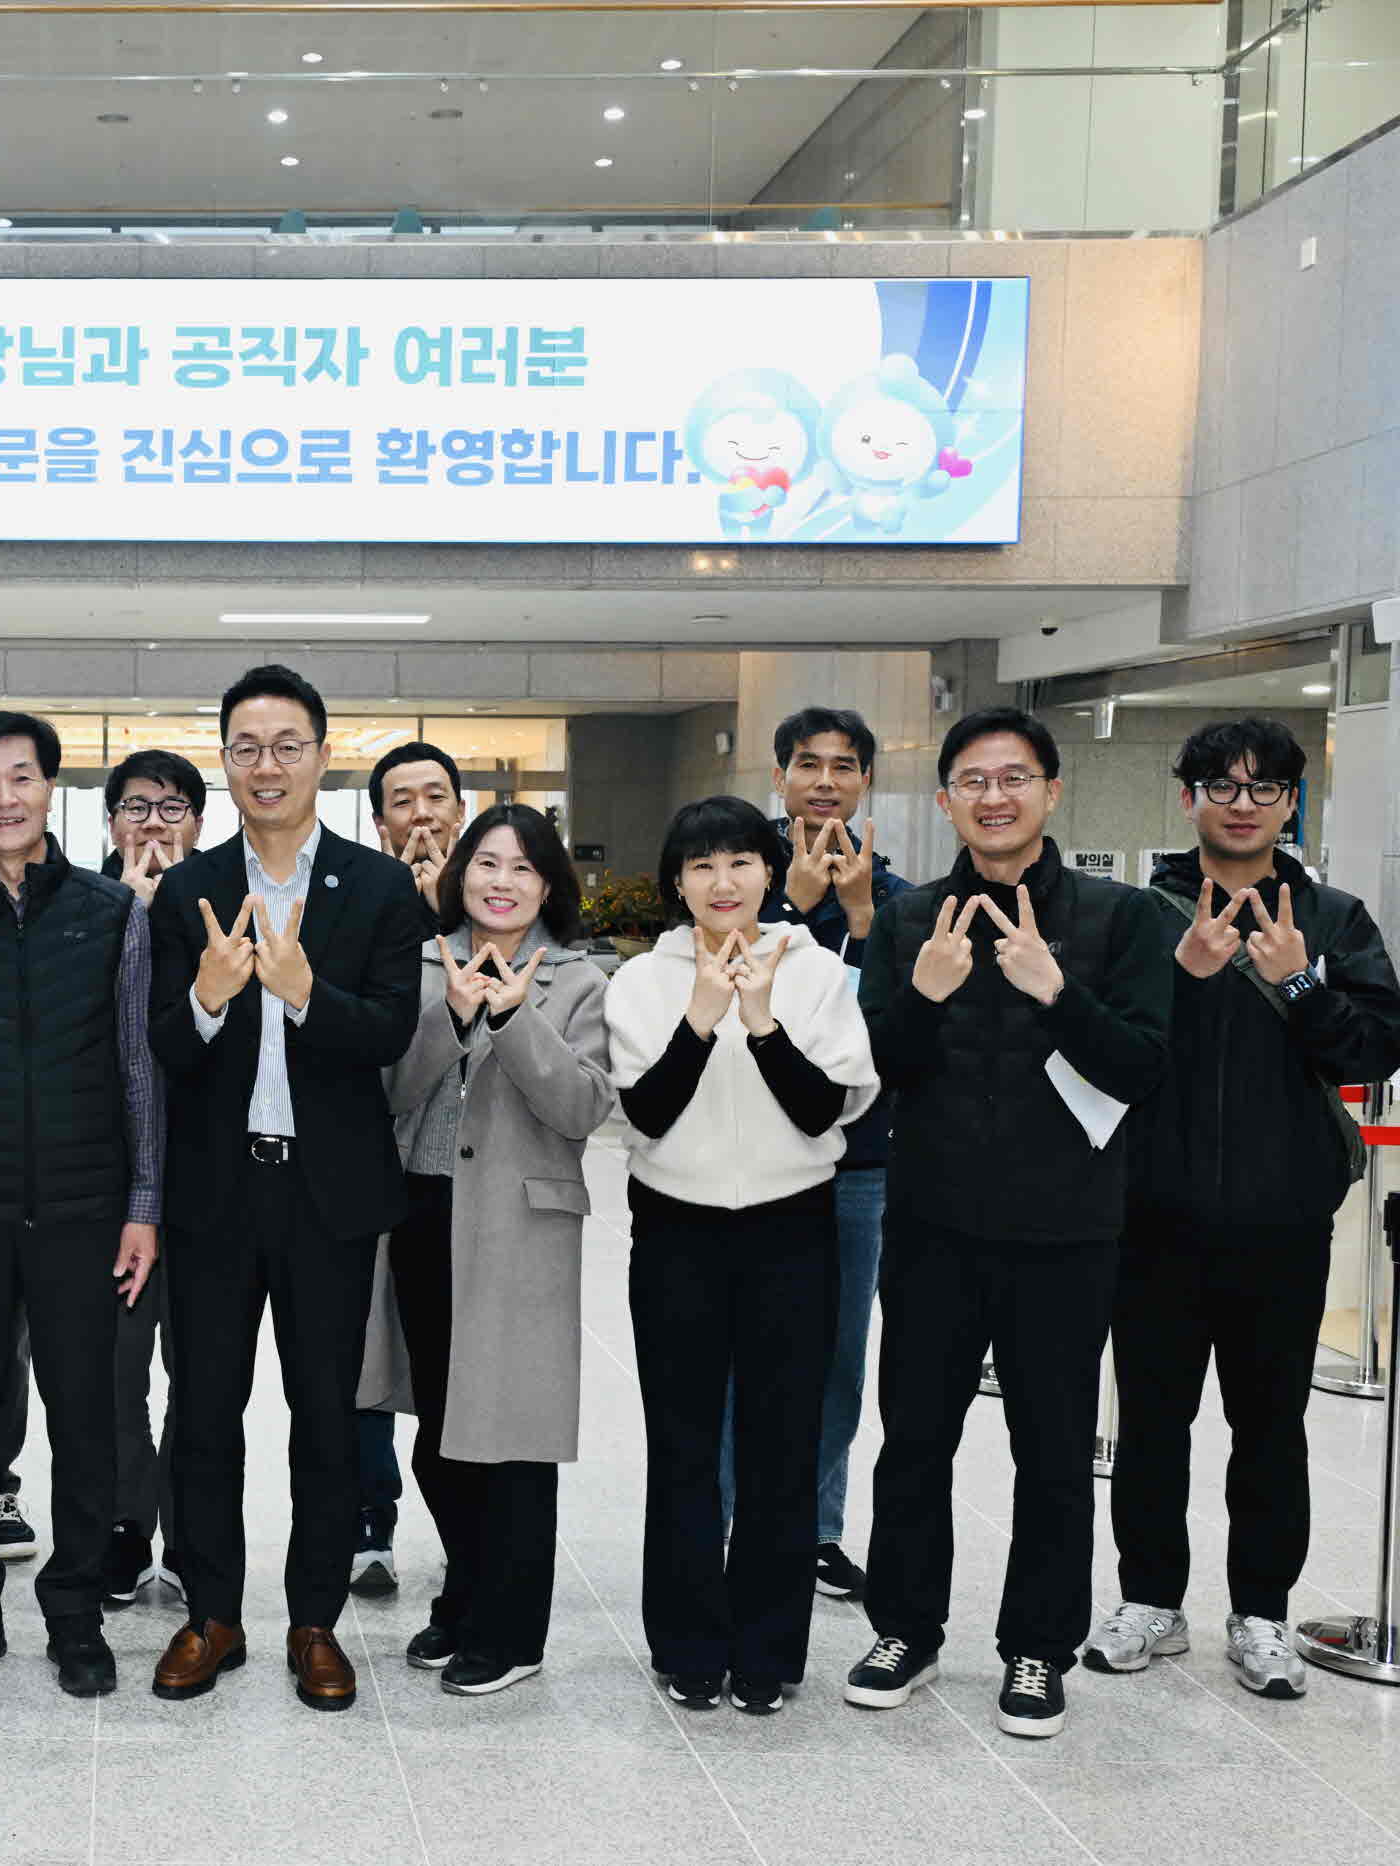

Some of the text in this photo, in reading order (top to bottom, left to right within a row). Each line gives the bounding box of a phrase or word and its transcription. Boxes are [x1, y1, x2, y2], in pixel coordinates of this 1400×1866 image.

[172, 326, 369, 389] 공직자
[394, 326, 588, 387] 여러분
[121, 427, 352, 484] 진심으로
[376, 427, 702, 486] 환영합니다.
[1075, 853, 1114, 867] 탈의실
